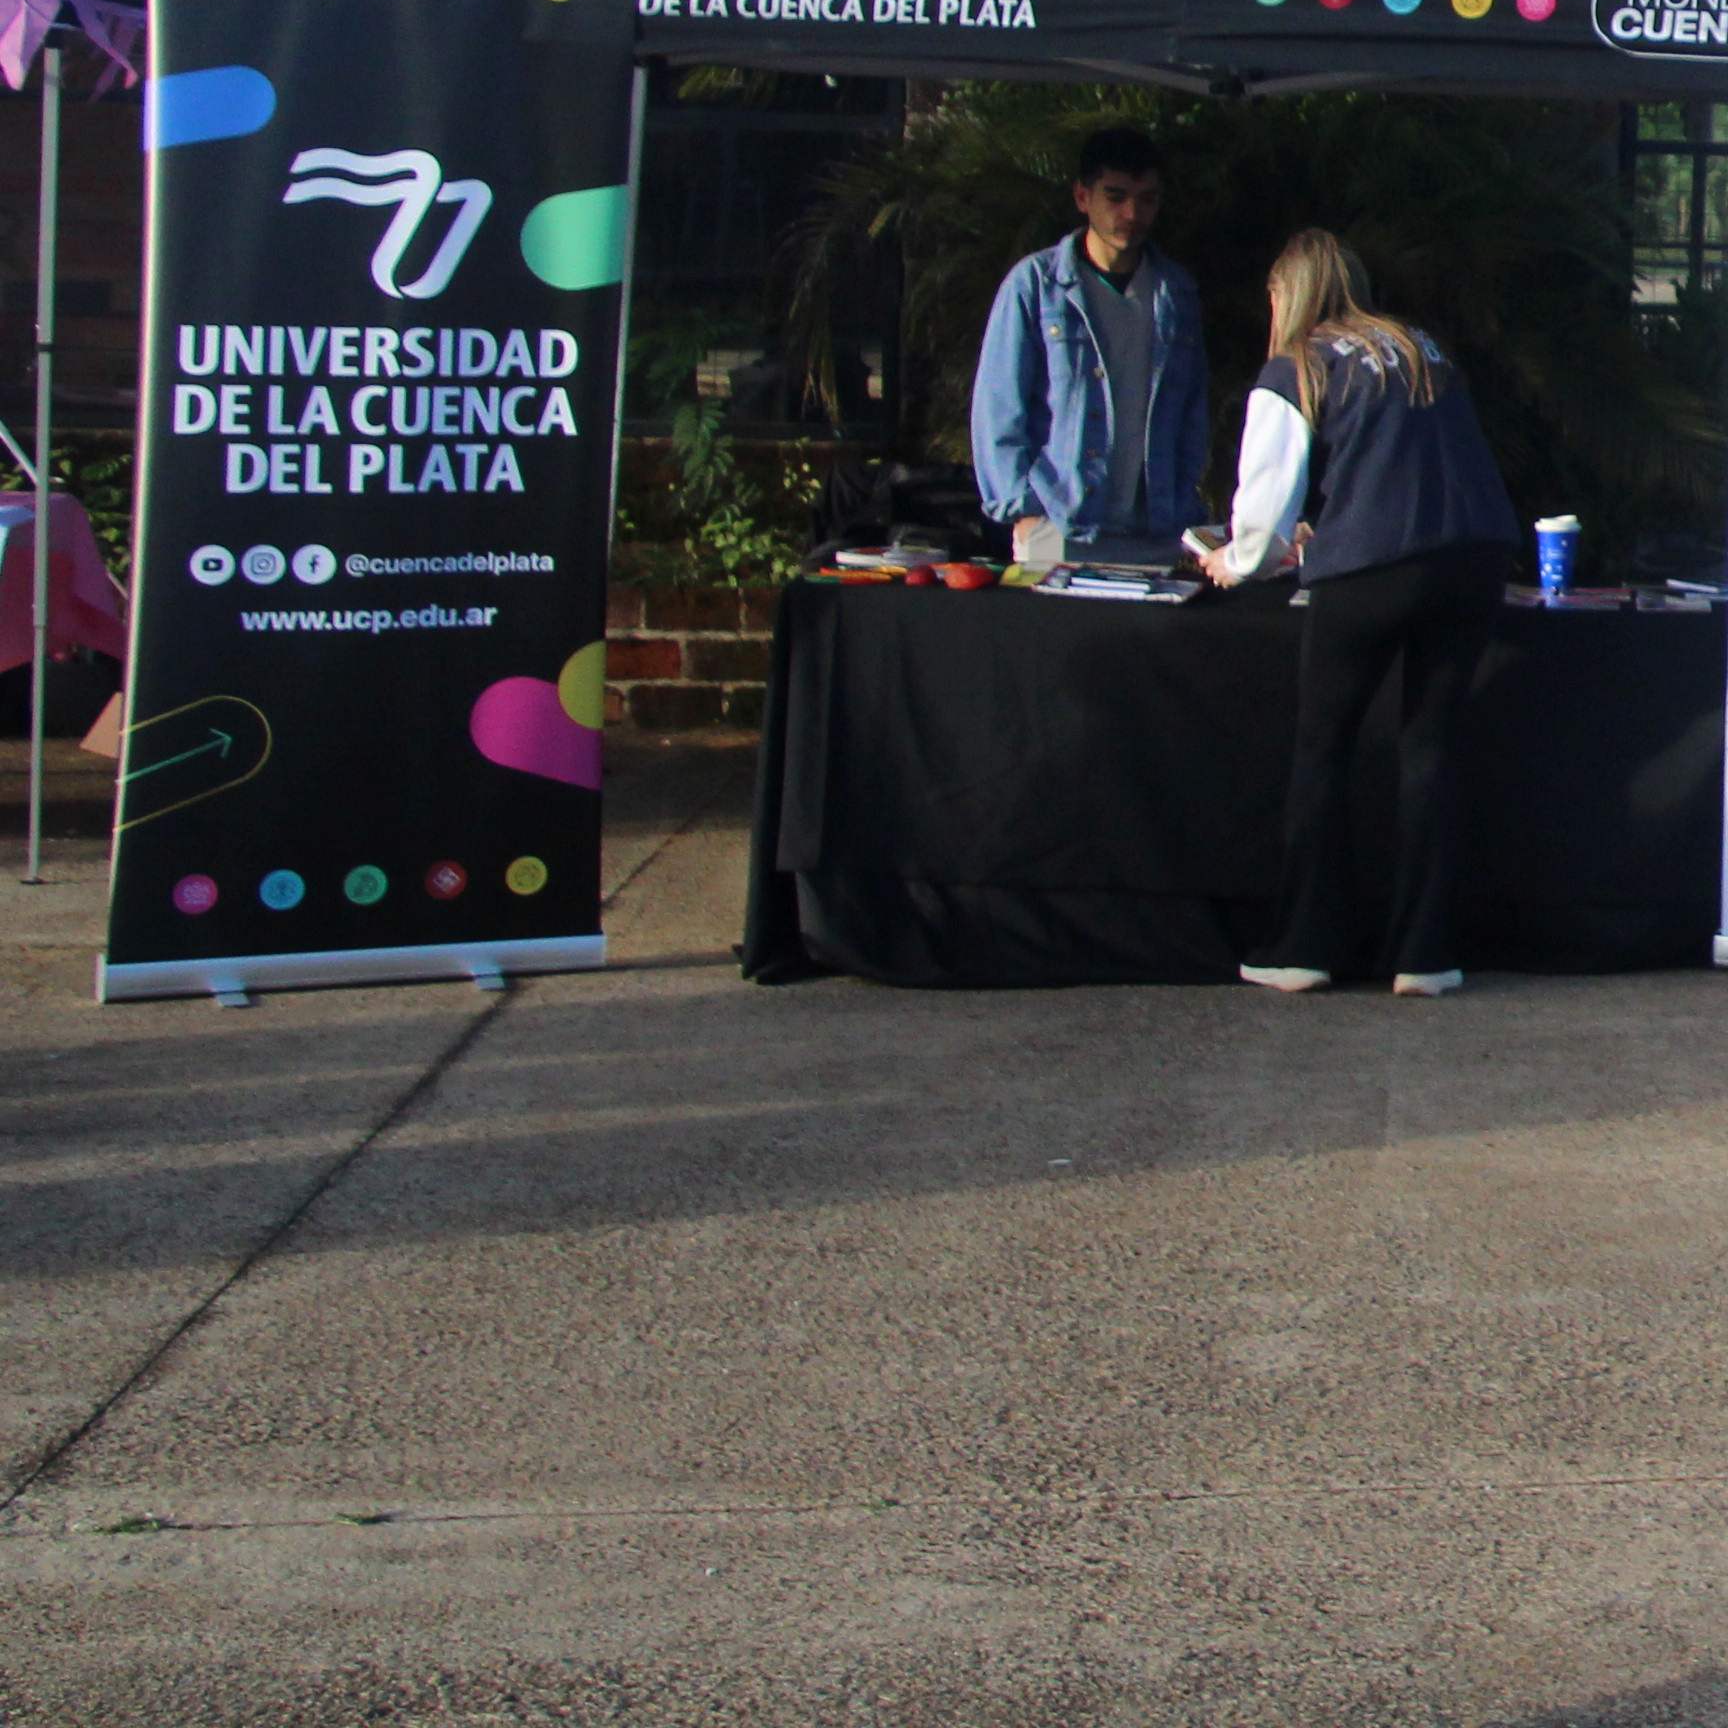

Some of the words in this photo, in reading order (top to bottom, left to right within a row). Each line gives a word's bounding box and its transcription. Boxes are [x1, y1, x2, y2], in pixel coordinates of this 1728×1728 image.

[177, 324, 579, 378] UNIVERSIDAD
[172, 383, 252, 435] DE
[267, 384, 341, 436] LA
[350, 385, 578, 436] CUENCA
[225, 443, 333, 494] DEL
[348, 443, 525, 493] PLATA
[345, 551, 555, 577] @cuencadelplata
[240, 603, 499, 633] www.ucp.edu.ar
